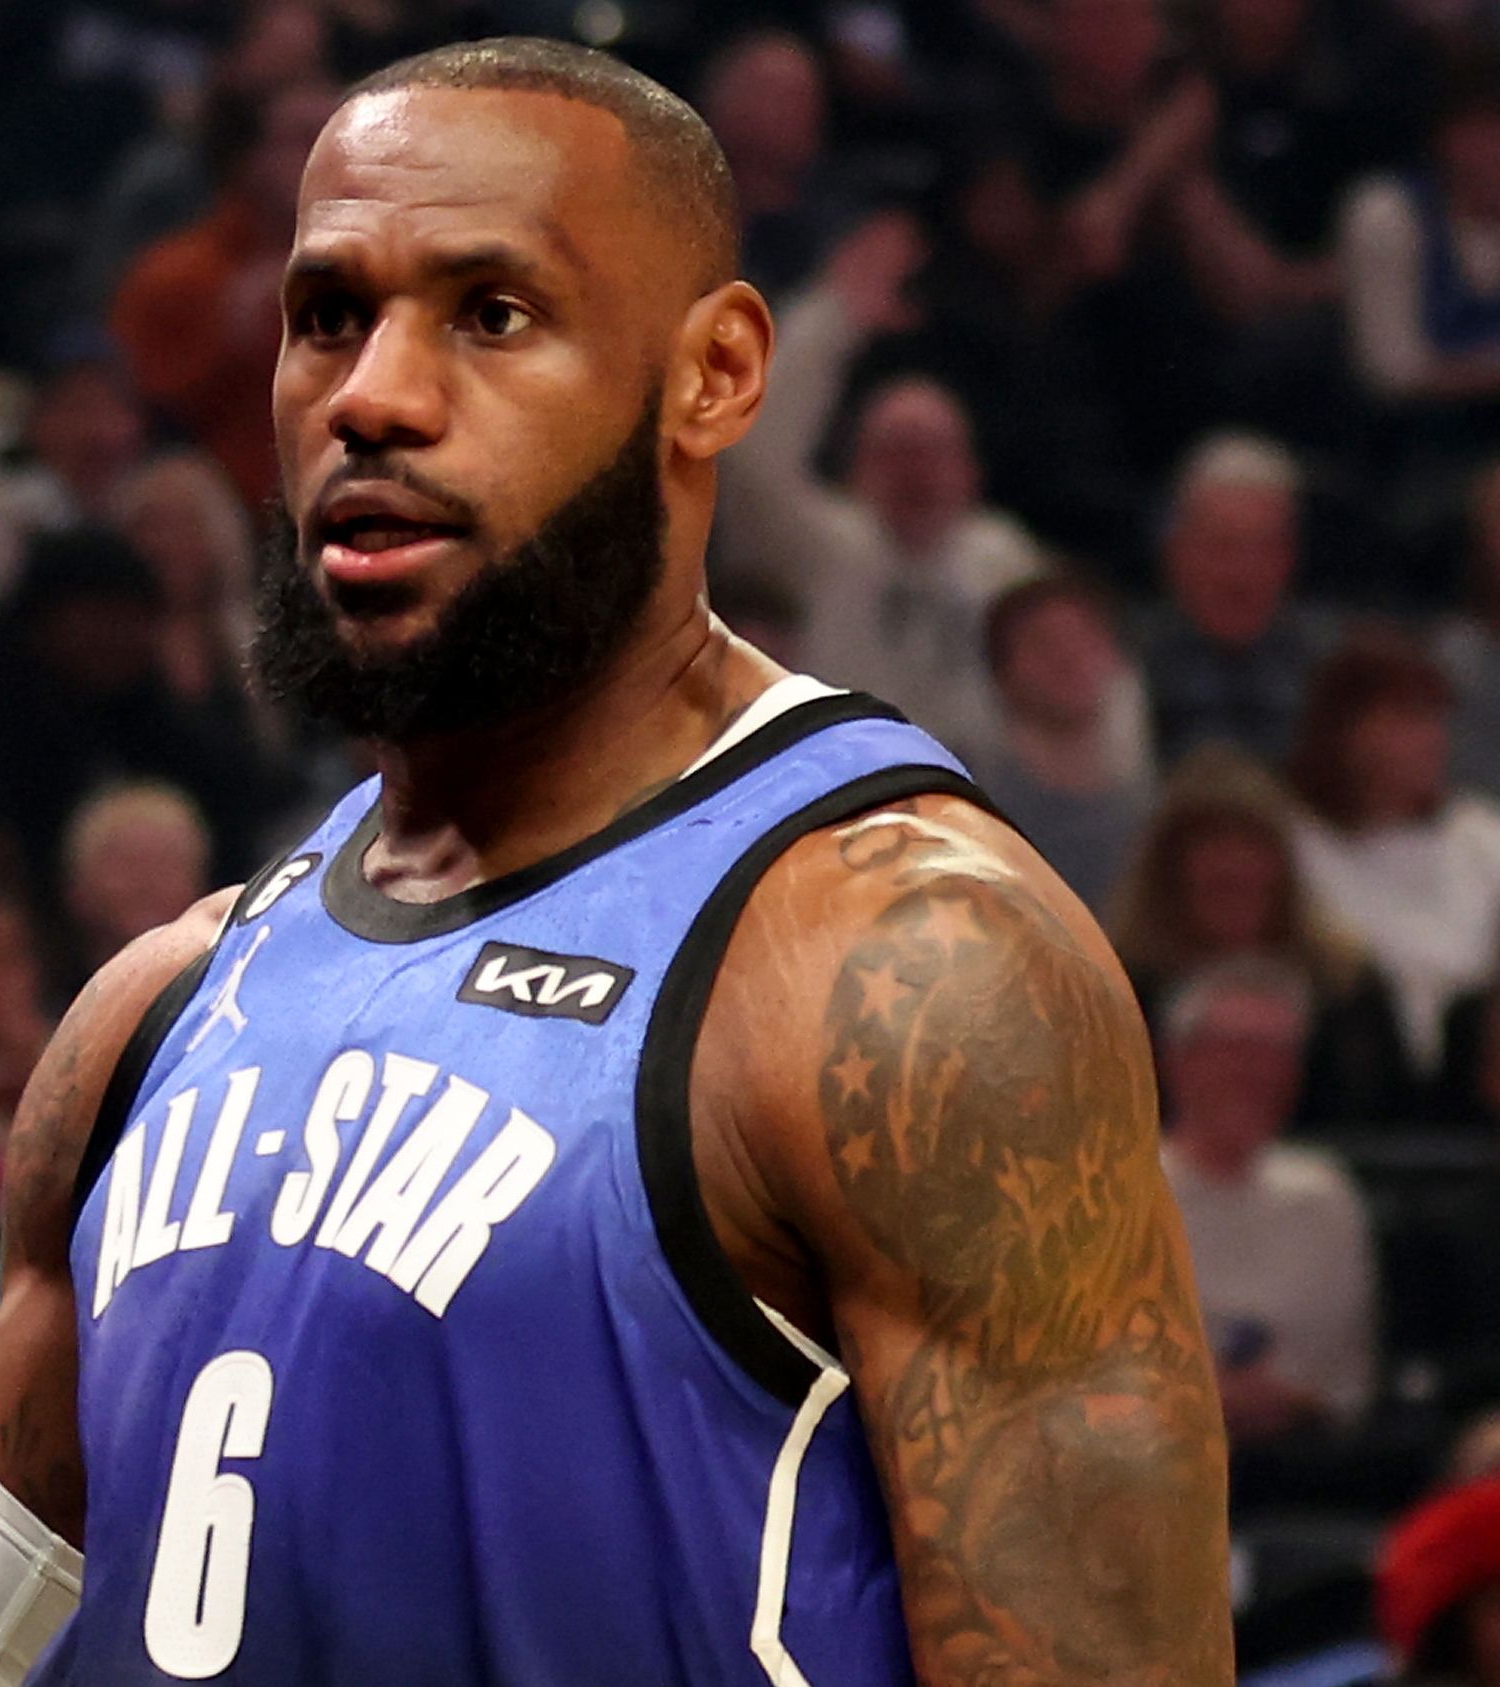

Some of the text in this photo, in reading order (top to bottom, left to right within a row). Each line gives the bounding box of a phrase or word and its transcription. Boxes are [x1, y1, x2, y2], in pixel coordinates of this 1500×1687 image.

[245, 858, 312, 920] 6
[92, 1048, 558, 1320] ALL-STAR
[143, 1349, 274, 1680] 6
